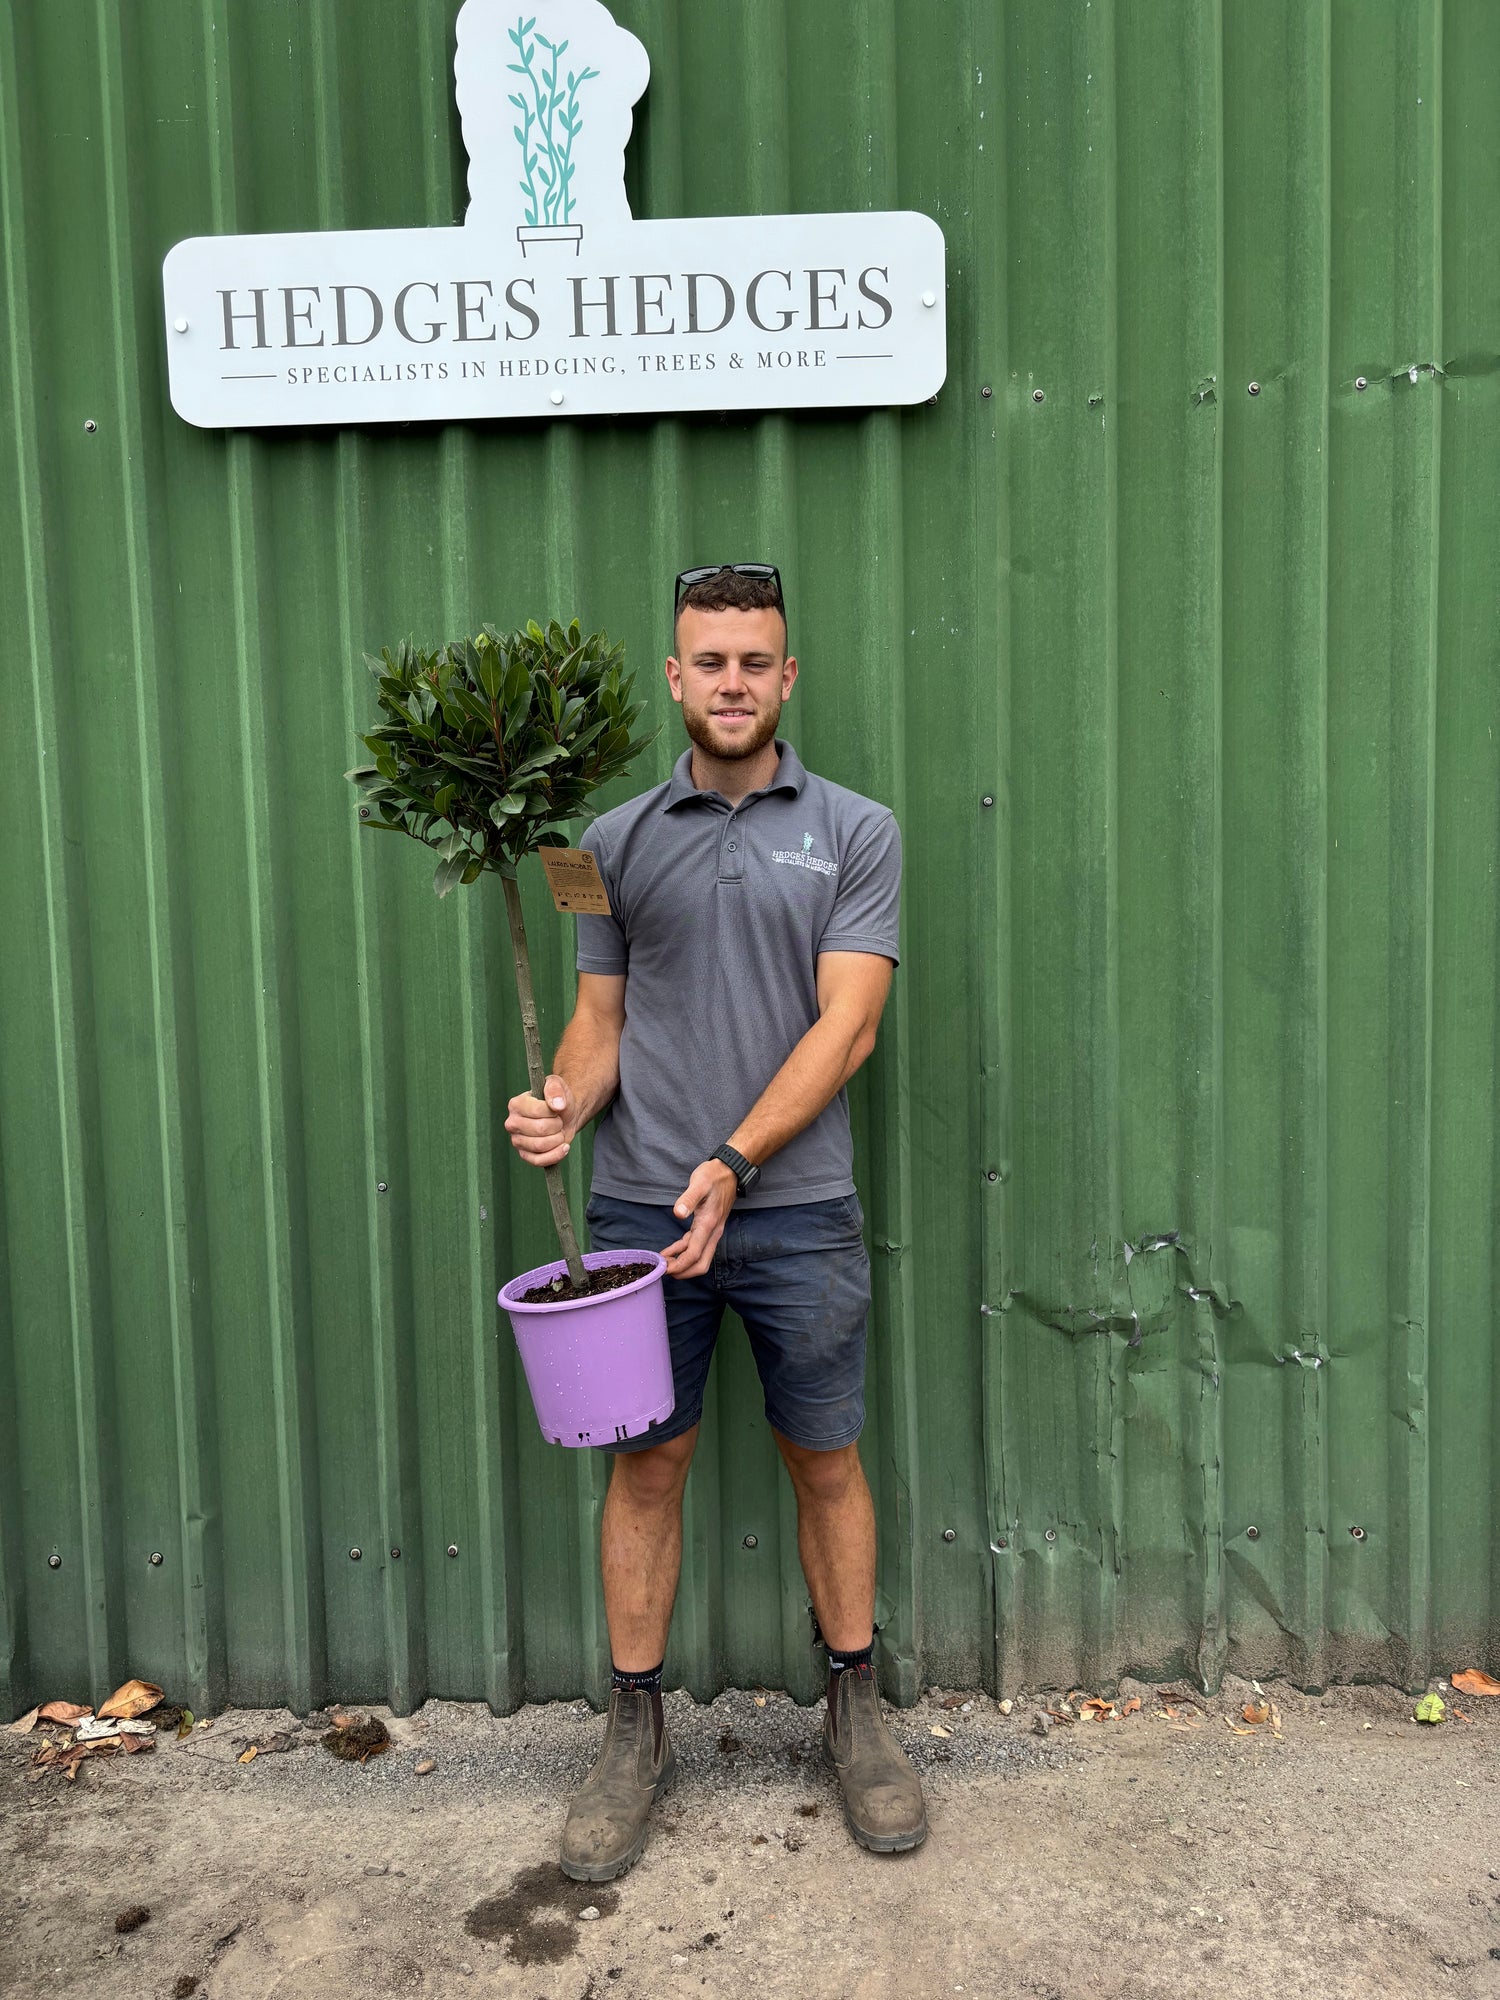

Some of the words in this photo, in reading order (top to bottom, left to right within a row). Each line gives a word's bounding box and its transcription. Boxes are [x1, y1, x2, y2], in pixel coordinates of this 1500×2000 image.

[215, 277, 540, 350] HEDGES
[567, 266, 893, 338] HEDGES
[287, 363, 449, 385] SPECIALISTS
[462, 361, 485, 378] IN
[499, 358, 626, 376] HEDGING,
[638, 354, 716, 372] TREES
[729, 352, 744, 369] &
[757, 350, 826, 369] MORE
[772, 850, 806, 861] HEDGES
[807, 855, 838, 872] HEDGES
